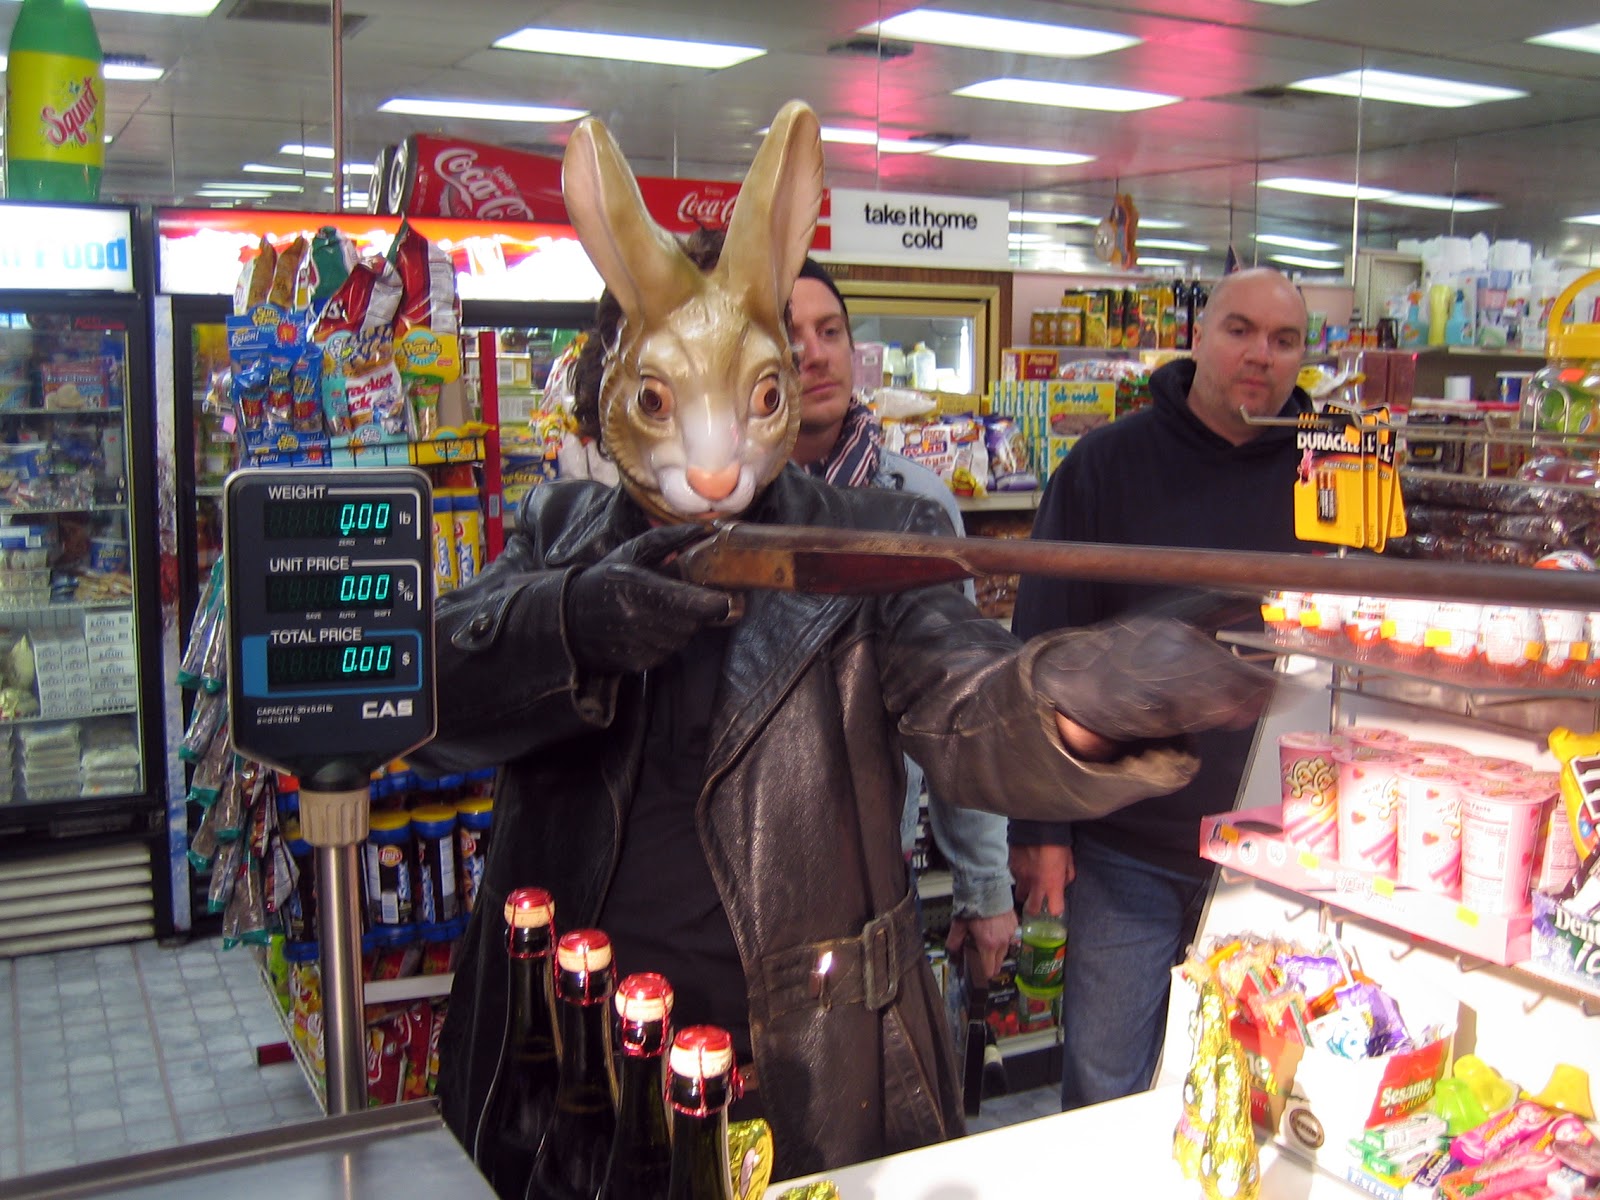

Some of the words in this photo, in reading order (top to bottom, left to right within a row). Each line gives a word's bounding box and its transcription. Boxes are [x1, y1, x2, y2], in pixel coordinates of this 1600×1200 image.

[42, 77, 98, 146] Squirt
[677, 192, 738, 223] Coca-C
[864, 203, 906, 225] take
[909, 205, 921, 226] it
[923, 206, 978, 230] home
[902, 228, 943, 249] cold
[268, 485, 326, 499] WEIGHT
[340, 503, 390, 530] 0.00
[399, 511, 411, 525] lb
[270, 557, 304, 573] UNIT
[307, 556, 350, 571] PRICE
[340, 574, 390, 601] 0.00
[270, 629, 317, 645] TOTAL
[320, 626, 362, 642] PRICE
[342, 645, 392, 673] 0.00
[402, 651, 411, 666] $
[362, 699, 413, 719] CAS
[1380, 1077, 1434, 1108] Sesame
